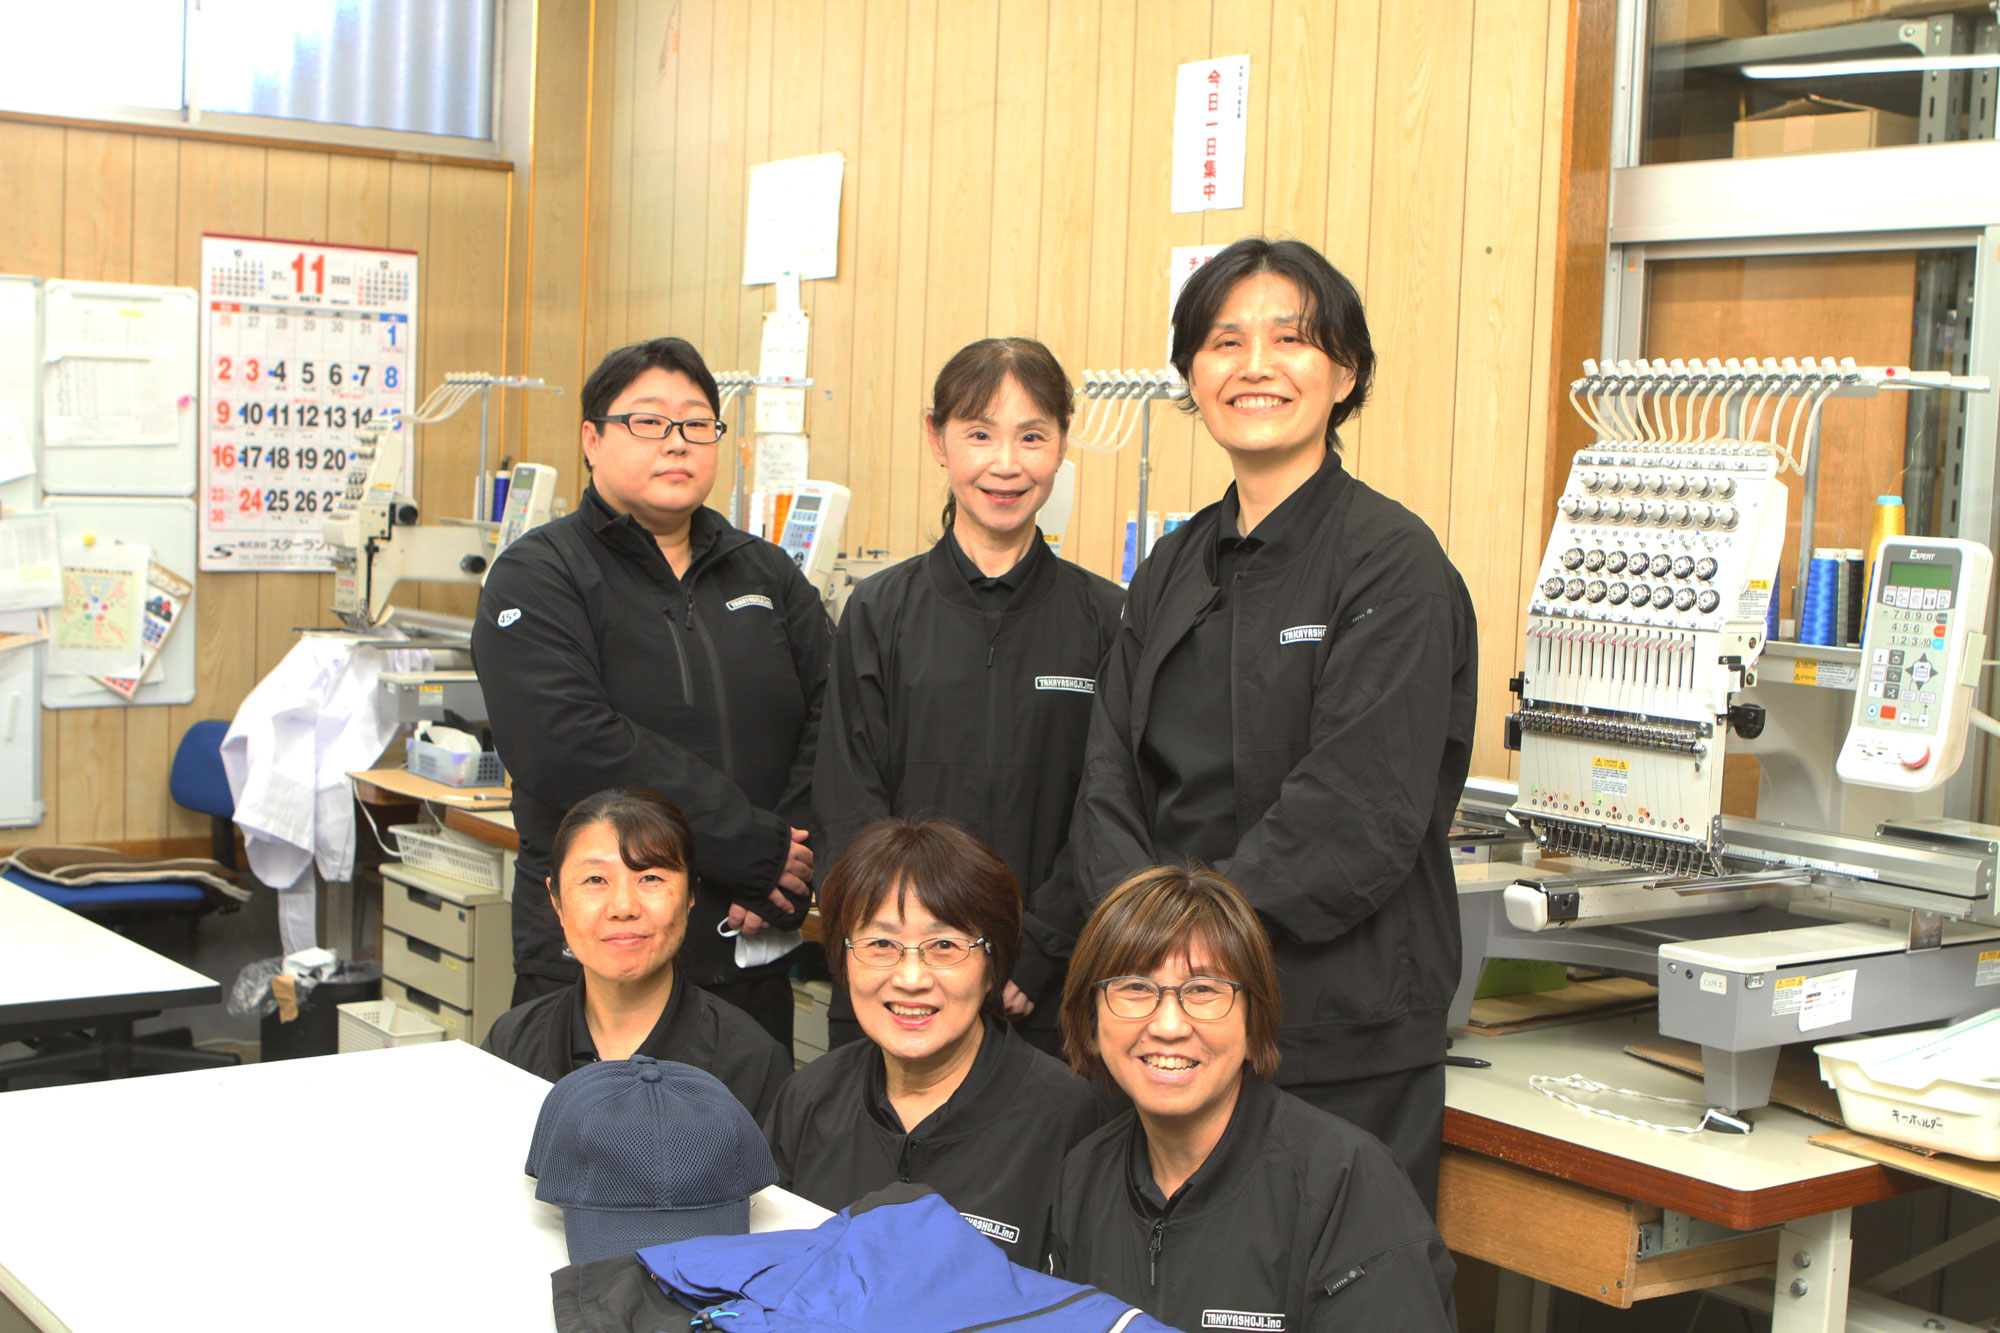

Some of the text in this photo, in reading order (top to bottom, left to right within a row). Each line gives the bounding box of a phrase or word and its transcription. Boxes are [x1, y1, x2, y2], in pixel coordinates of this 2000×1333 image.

[1203, 69, 1221, 201] 今日一日集中
[291, 253, 325, 294] 11
[387, 324, 396, 346] 1
[218, 357, 398, 388] 2 3 4 5 6 7 8
[217, 401, 230, 424] 9
[241, 402, 263, 426] 10
[270, 404, 289, 426] 11
[296, 405, 319, 427] 12
[324, 406, 346, 428] 13
[351, 407, 373, 428] 14
[212, 444, 346, 470] 16 17 18 19 20
[239, 488, 262, 511] 24
[267, 490, 289, 511] 25
[294, 491, 317, 512] 26
[322, 491, 341, 512] 2
[210, 509, 225, 522] 30
[1893, 610, 1899, 618] 7
[1904, 611, 1910, 619] 8
[1915, 612, 1921, 620] 9
[1891, 623, 1919, 632] 4 5 6
[1901, 636, 1907, 644] 2
[1912, 637, 1917, 645] 3
[1892, 1109, 1943, 1129] キーホルダー
[1206, 1313, 1282, 1329] TAKAYASHOJI.inc
